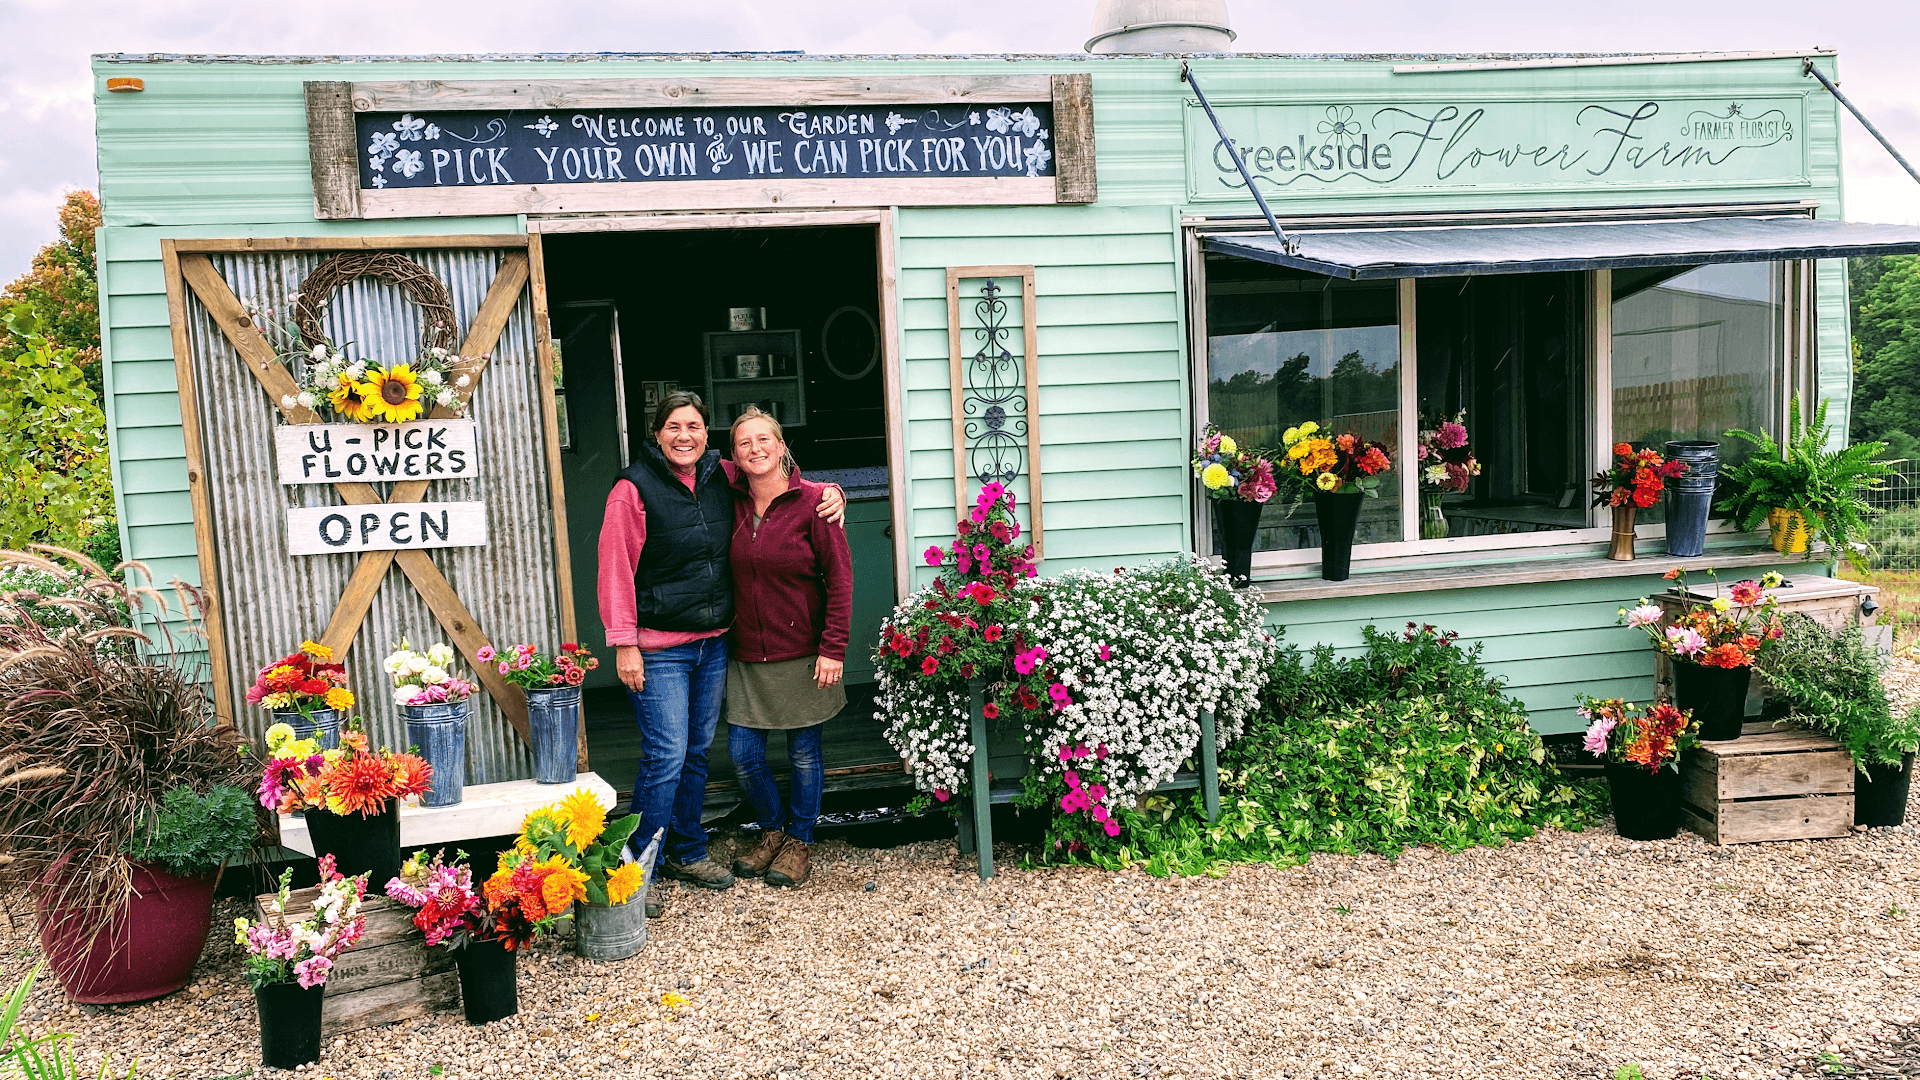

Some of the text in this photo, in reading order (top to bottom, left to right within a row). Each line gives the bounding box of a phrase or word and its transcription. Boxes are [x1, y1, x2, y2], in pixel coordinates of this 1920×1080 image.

[693, 116, 715, 136] TO
[727, 115, 767, 136] OUR
[1694, 120, 1781, 140] FARMER FLORIST
[1212, 101, 1735, 181] Creekside Flower Farm
[430, 147, 515, 185] PICK
[533, 146, 628, 182] YOUR
[634, 142, 697, 178] OWN
[743, 140, 784, 175] WE
[793, 139, 847, 175] CAN
[859, 138, 919, 173] PICK
[922, 137, 970, 173] FOR
[971, 135, 1024, 171] YOU
[308, 429, 333, 453] U
[373, 427, 448, 452] PICK
[302, 451, 466, 478] FLOWERS
[318, 510, 449, 547] OPEN
